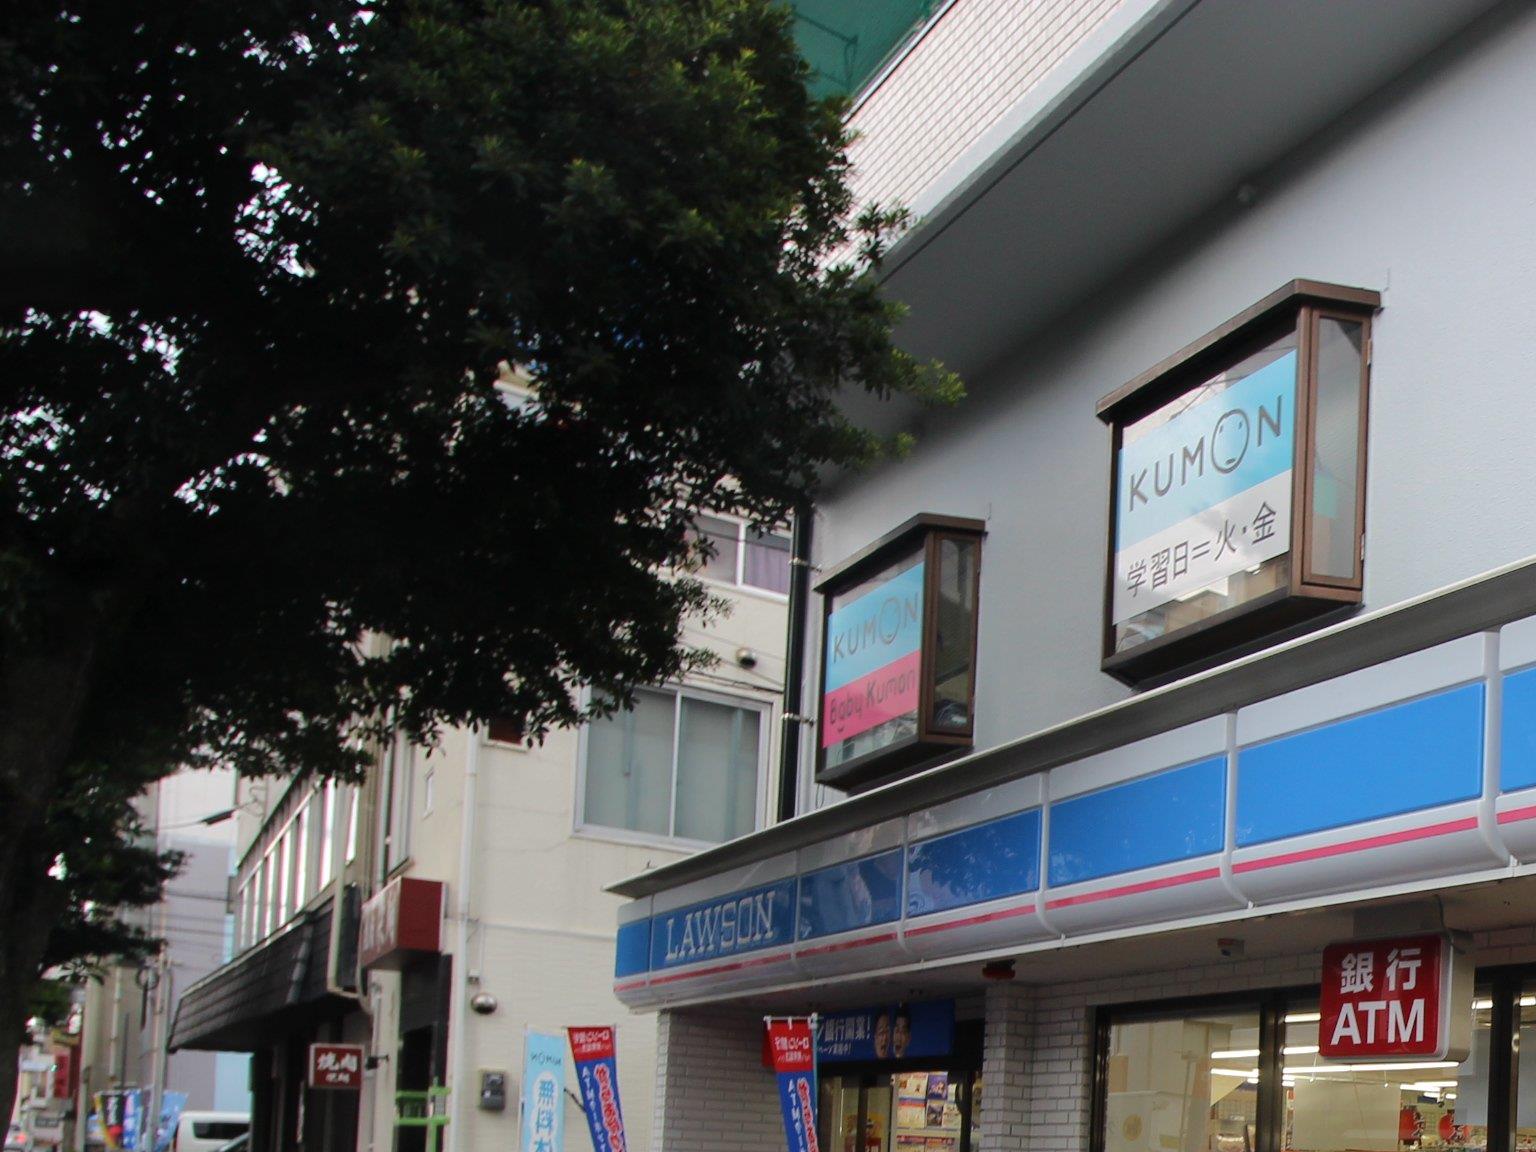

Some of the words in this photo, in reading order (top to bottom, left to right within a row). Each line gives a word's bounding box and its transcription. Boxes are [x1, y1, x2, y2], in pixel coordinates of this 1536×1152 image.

[1129, 395, 1283, 511] KUMON
[833, 592, 919, 663] KUMON
[830, 691, 863, 728] Baby
[866, 669, 915, 706] Kumon
[665, 890, 776, 960] LAWSON
[1340, 946, 1423, 995] 銀行
[1330, 999, 1426, 1046] ATM
